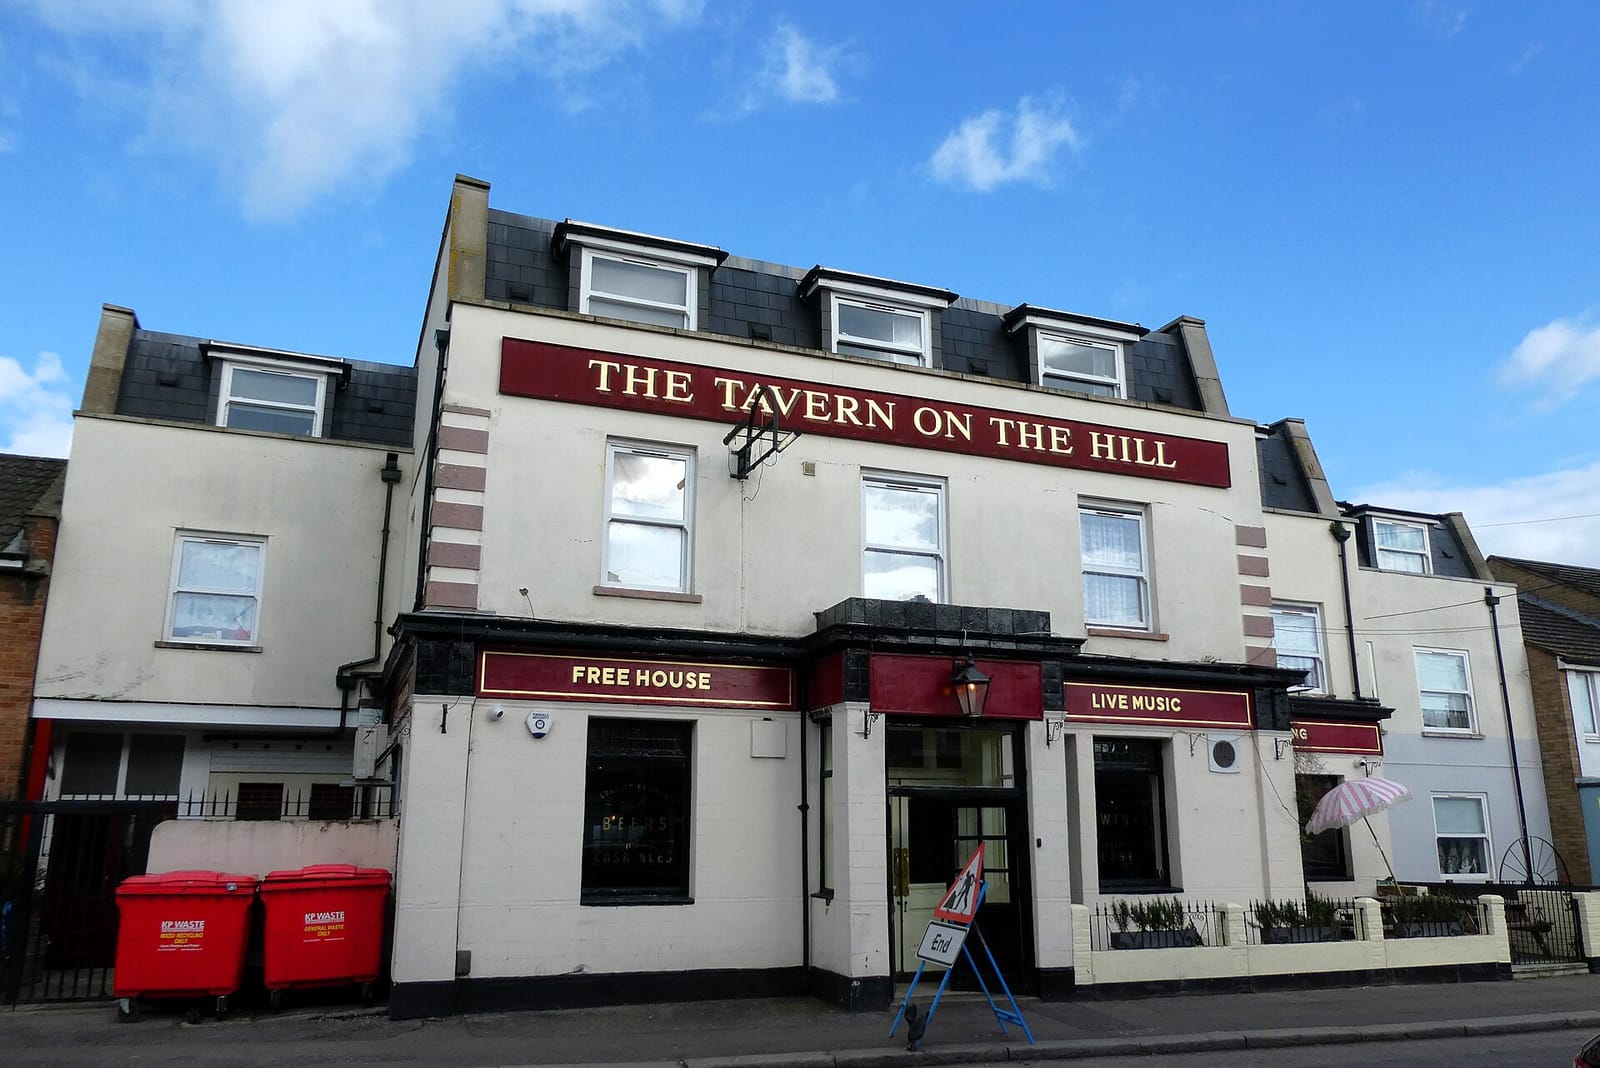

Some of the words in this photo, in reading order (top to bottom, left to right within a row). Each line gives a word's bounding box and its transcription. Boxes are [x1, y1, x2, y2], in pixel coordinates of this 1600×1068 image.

[588, 359, 695, 404] THE
[714, 376, 897, 431] TAVERN
[913, 406, 973, 441] ON
[989, 416, 1074, 454] THE
[1089, 431, 1178, 469] HILL
[572, 666, 630, 686] FREE
[636, 670, 712, 690] HOUSE
[1092, 693, 1128, 710] LIVE
[1132, 695, 1182, 712] MUSIC
[602, 816, 668, 831] BEERS
[174, 920, 205, 929] WASTE
[305, 912, 316, 921] KP
[316, 911, 345, 921] WASTE
[931, 934, 952, 954] End
